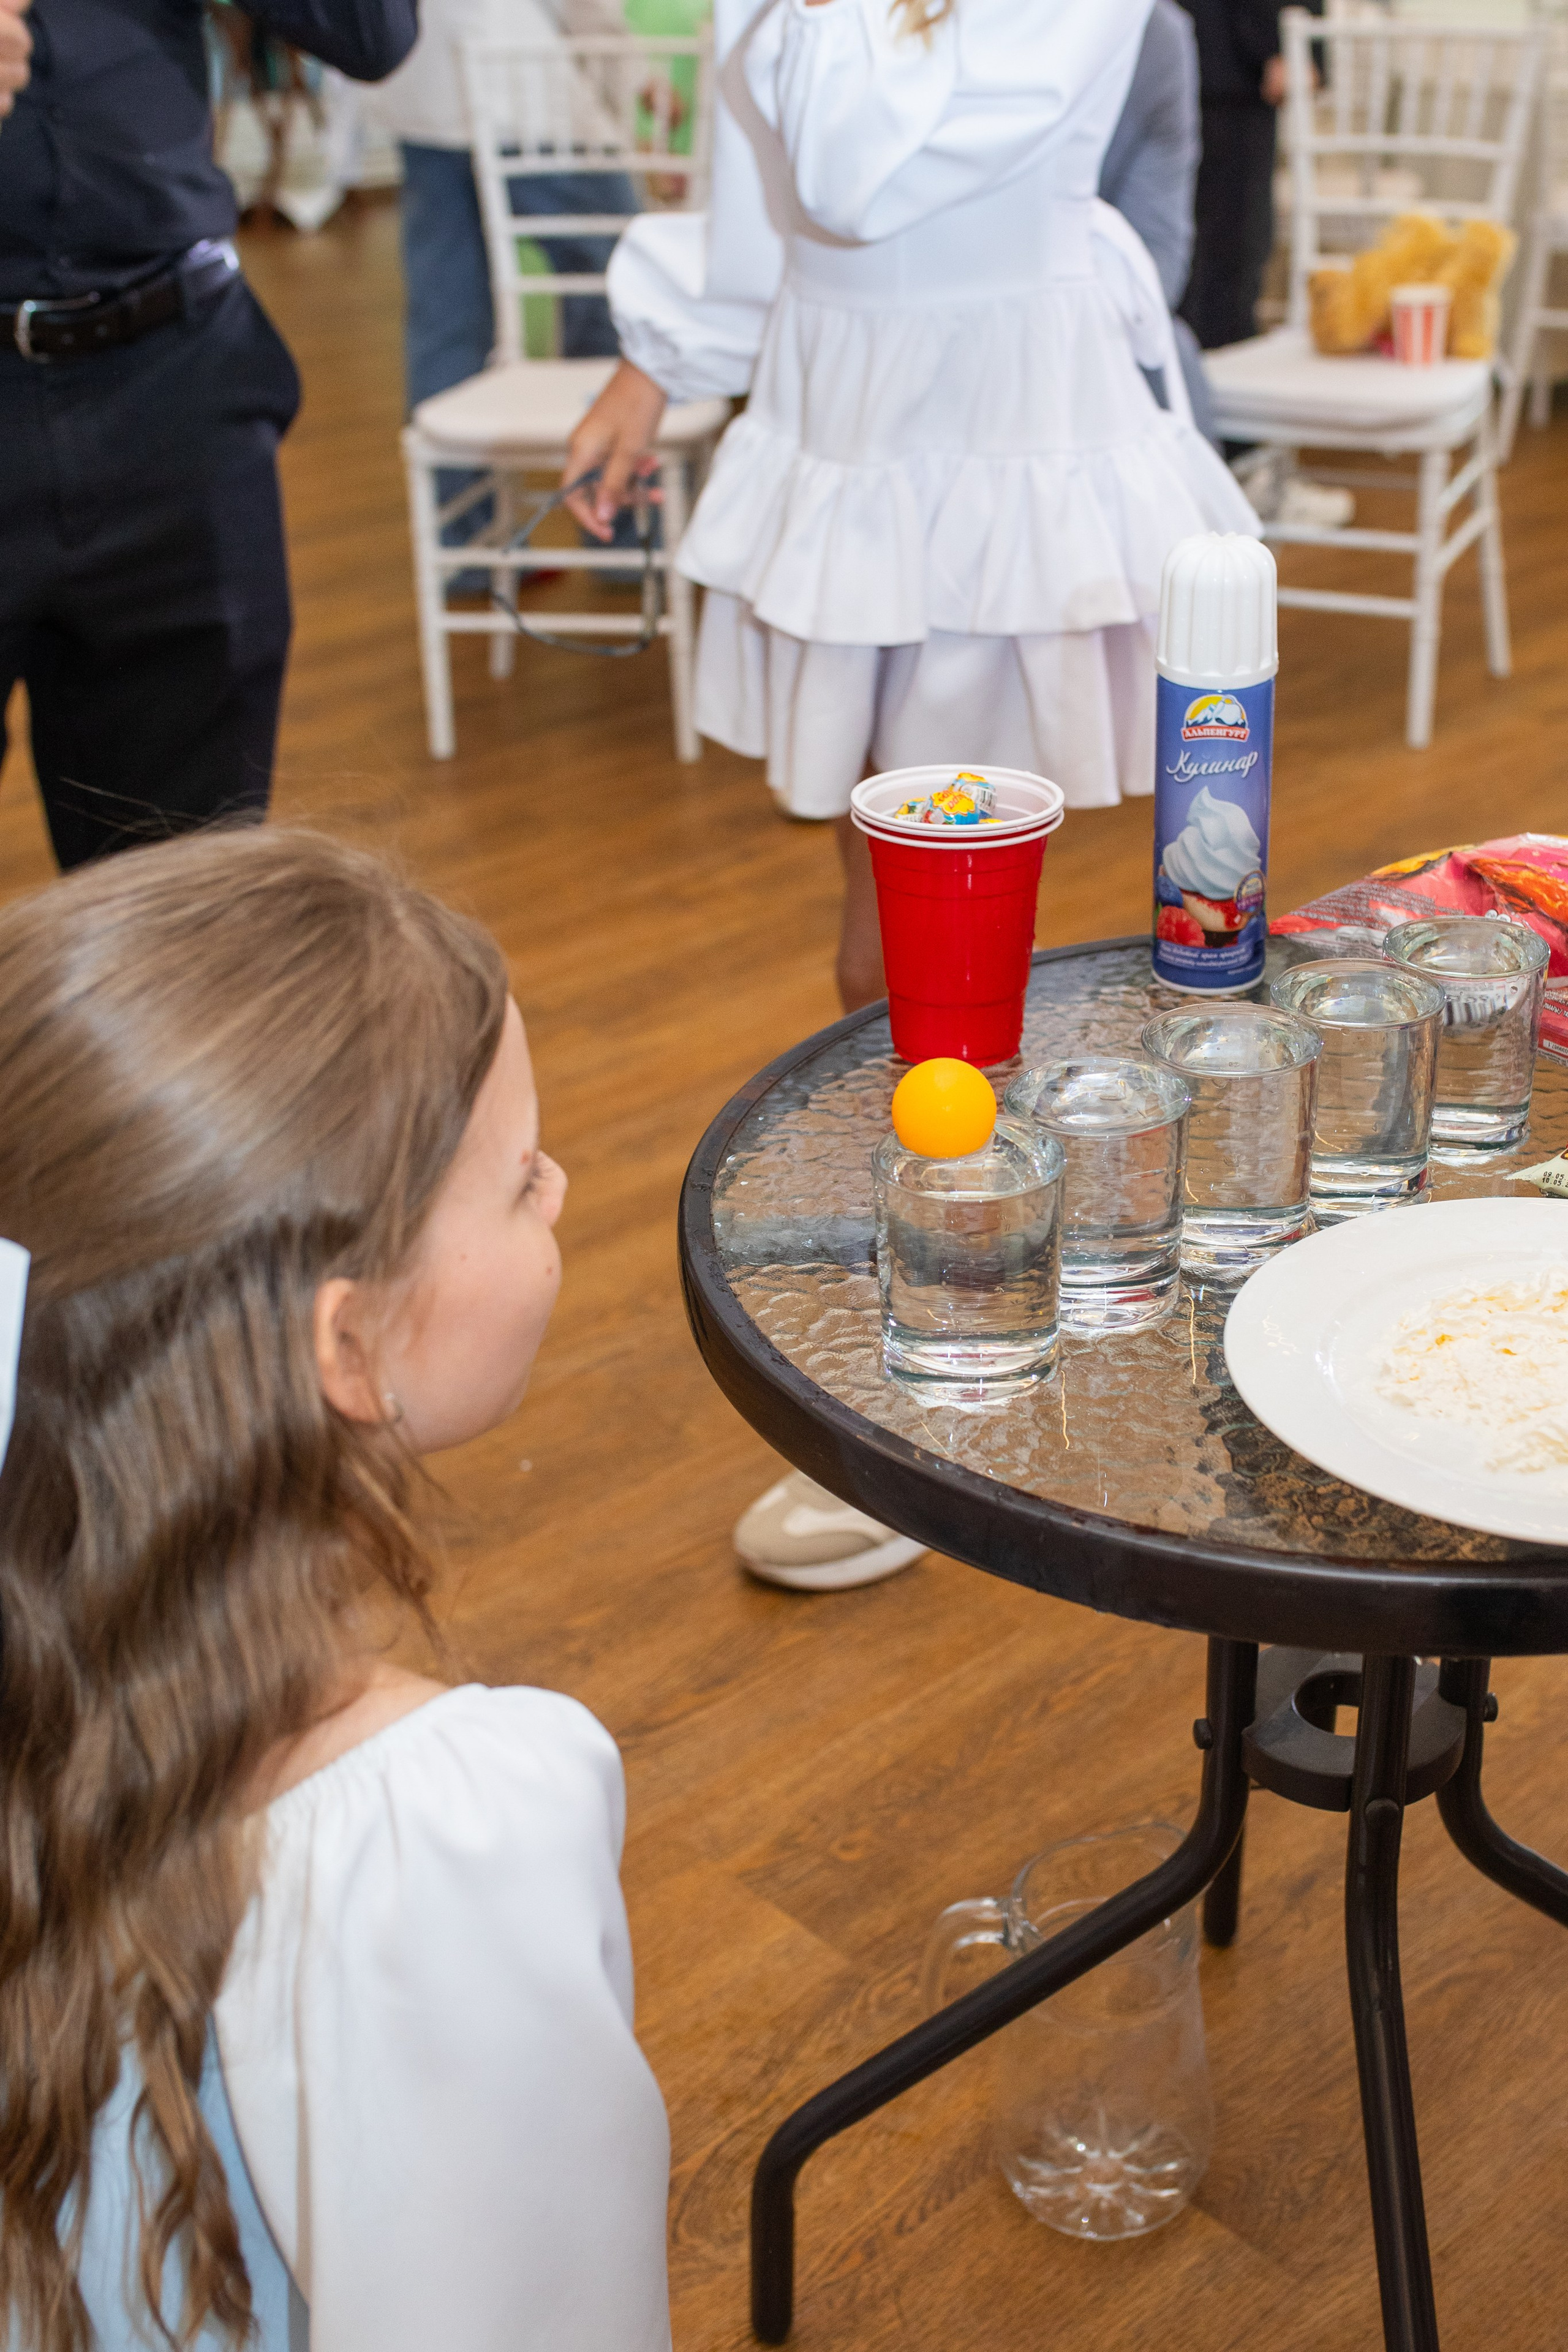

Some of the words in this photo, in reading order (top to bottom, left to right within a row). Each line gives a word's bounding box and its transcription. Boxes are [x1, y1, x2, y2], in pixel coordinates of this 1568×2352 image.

[1185, 728, 1246, 739] АЛЬПЕНГУРТ
[1166, 749, 1259, 783] Кулинар
[1543, 1171, 1568, 1181] 09.05.
